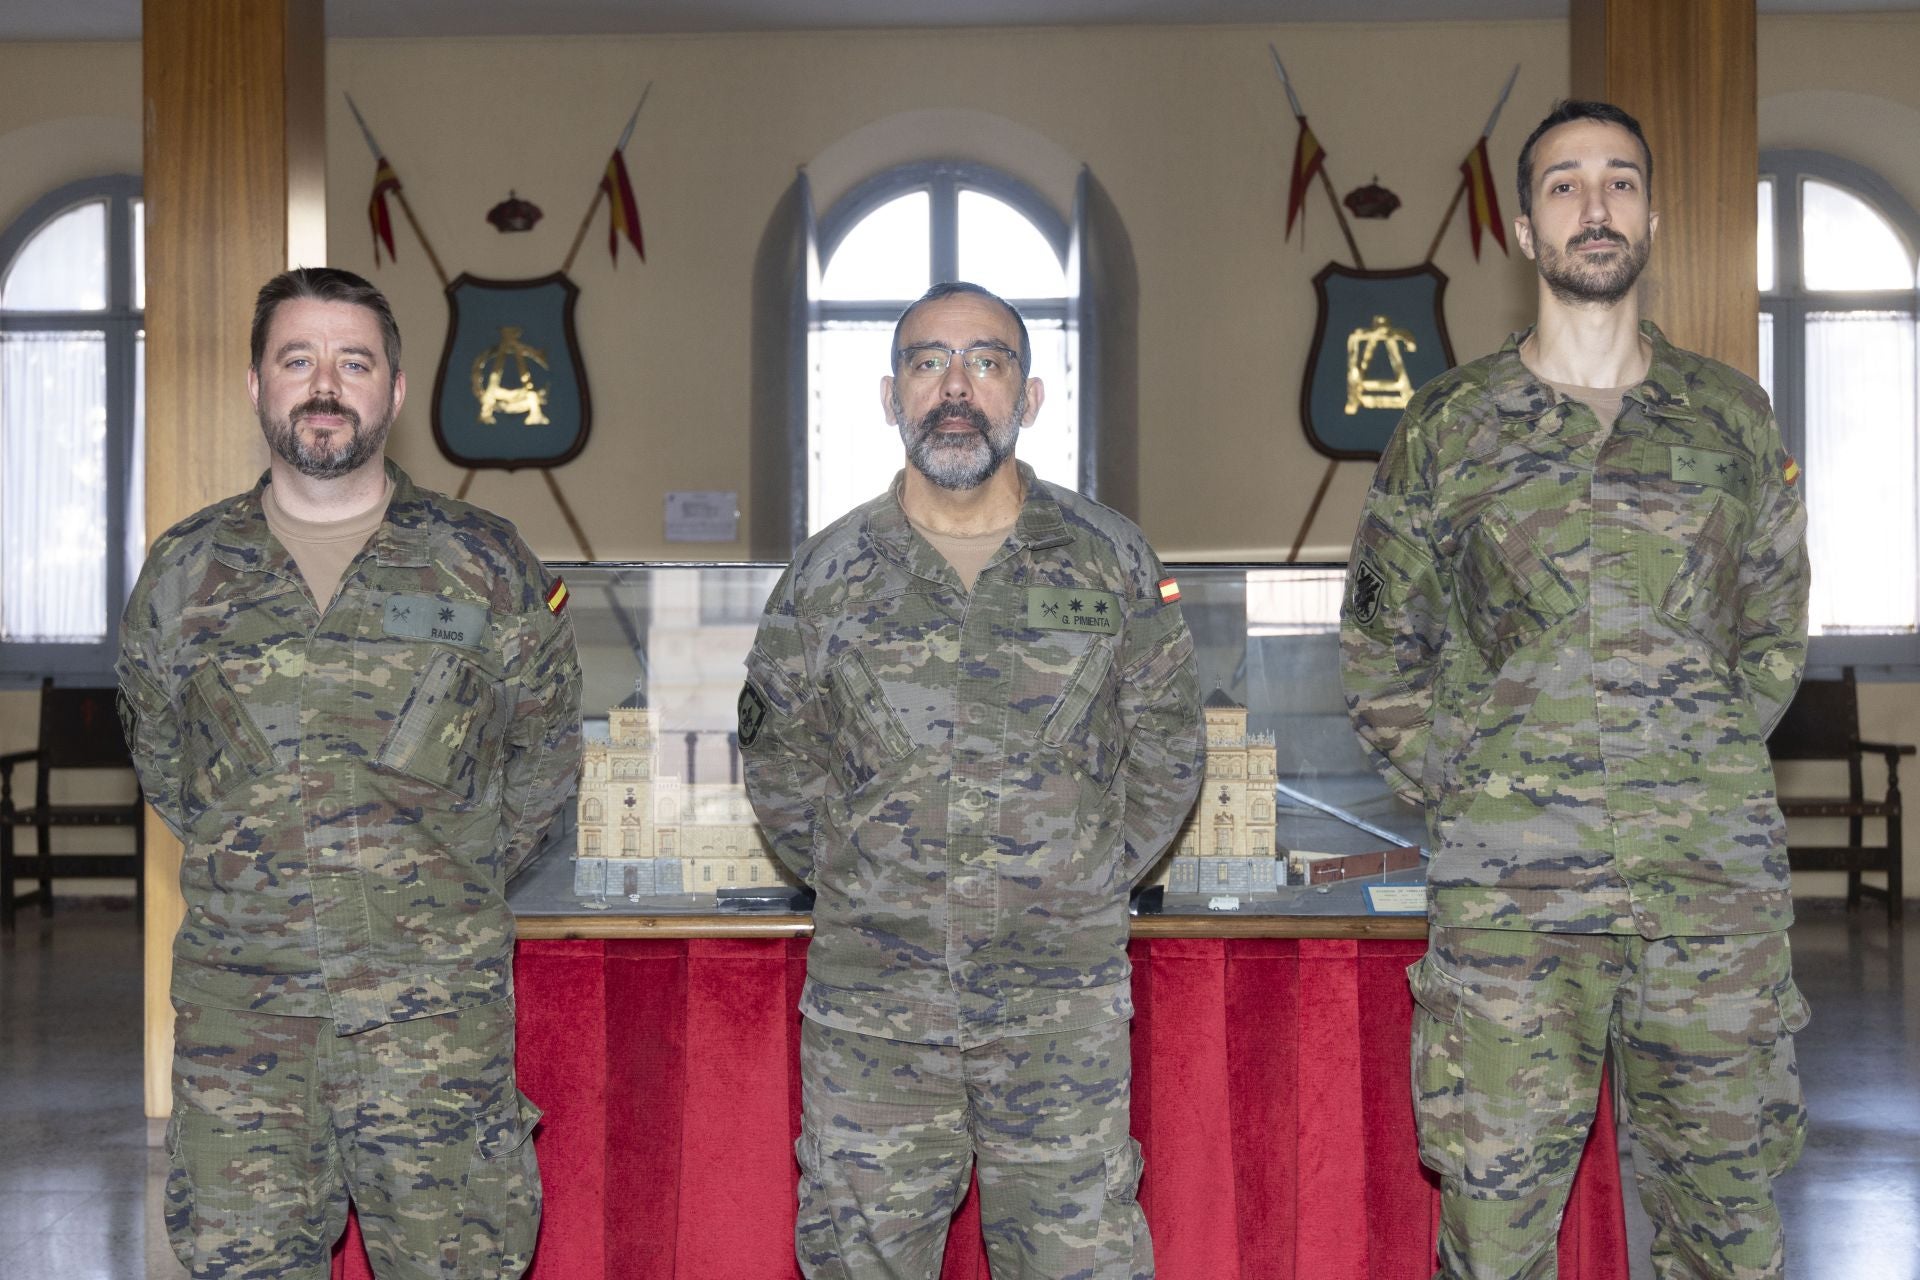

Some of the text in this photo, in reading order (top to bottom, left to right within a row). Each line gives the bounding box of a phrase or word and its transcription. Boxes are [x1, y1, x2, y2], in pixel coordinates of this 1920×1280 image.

[1062, 615, 1110, 627] G. PIMIENTA
[431, 628, 464, 641] RAMOS
